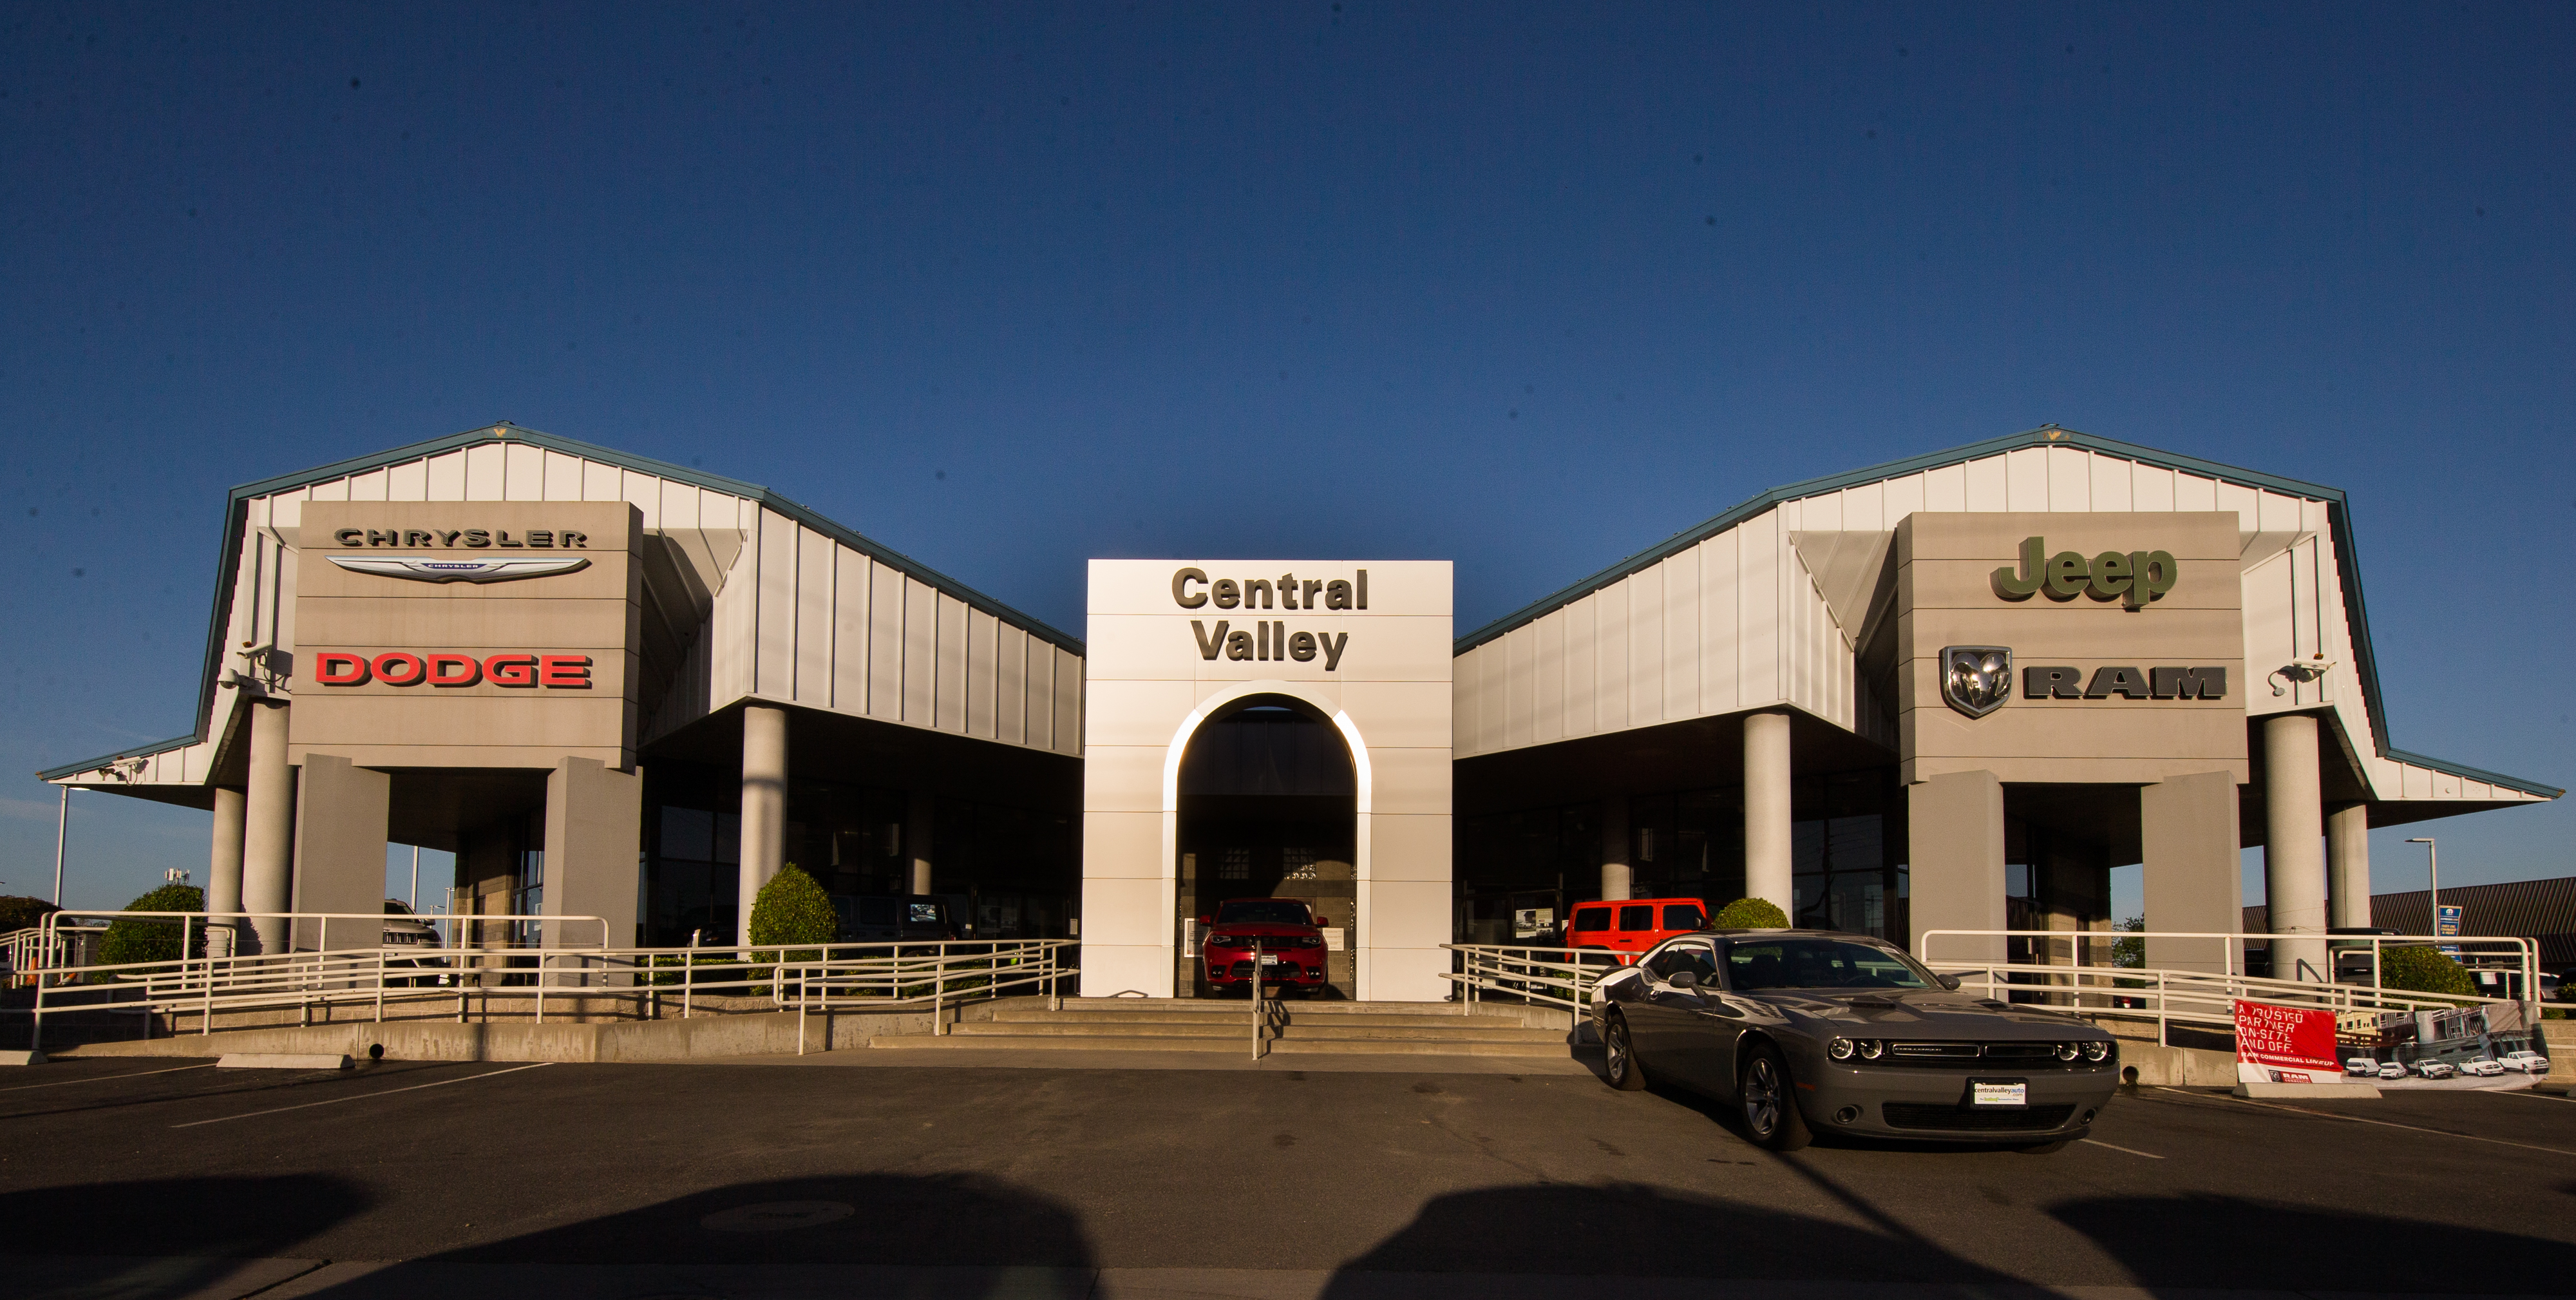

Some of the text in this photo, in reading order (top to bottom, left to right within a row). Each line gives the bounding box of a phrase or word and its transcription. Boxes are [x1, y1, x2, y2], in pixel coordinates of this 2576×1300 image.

[334, 528, 587, 548] CHRYSLER
[1989, 536, 2178, 611] Jeep
[1171, 568, 1368, 611] Central
[1190, 620, 1349, 671] Valley
[316, 653, 592, 689] DODGE
[2023, 666, 2228, 700] RAM
[2239, 1004, 2245, 1014] A
[2239, 1015, 2295, 1033] PARTNER
[2240, 1027, 2292, 1042] ON-SITE
[2240, 1038, 2294, 1053] AND OFF.
[2260, 1053, 2304, 1064] COMMERCIAL
